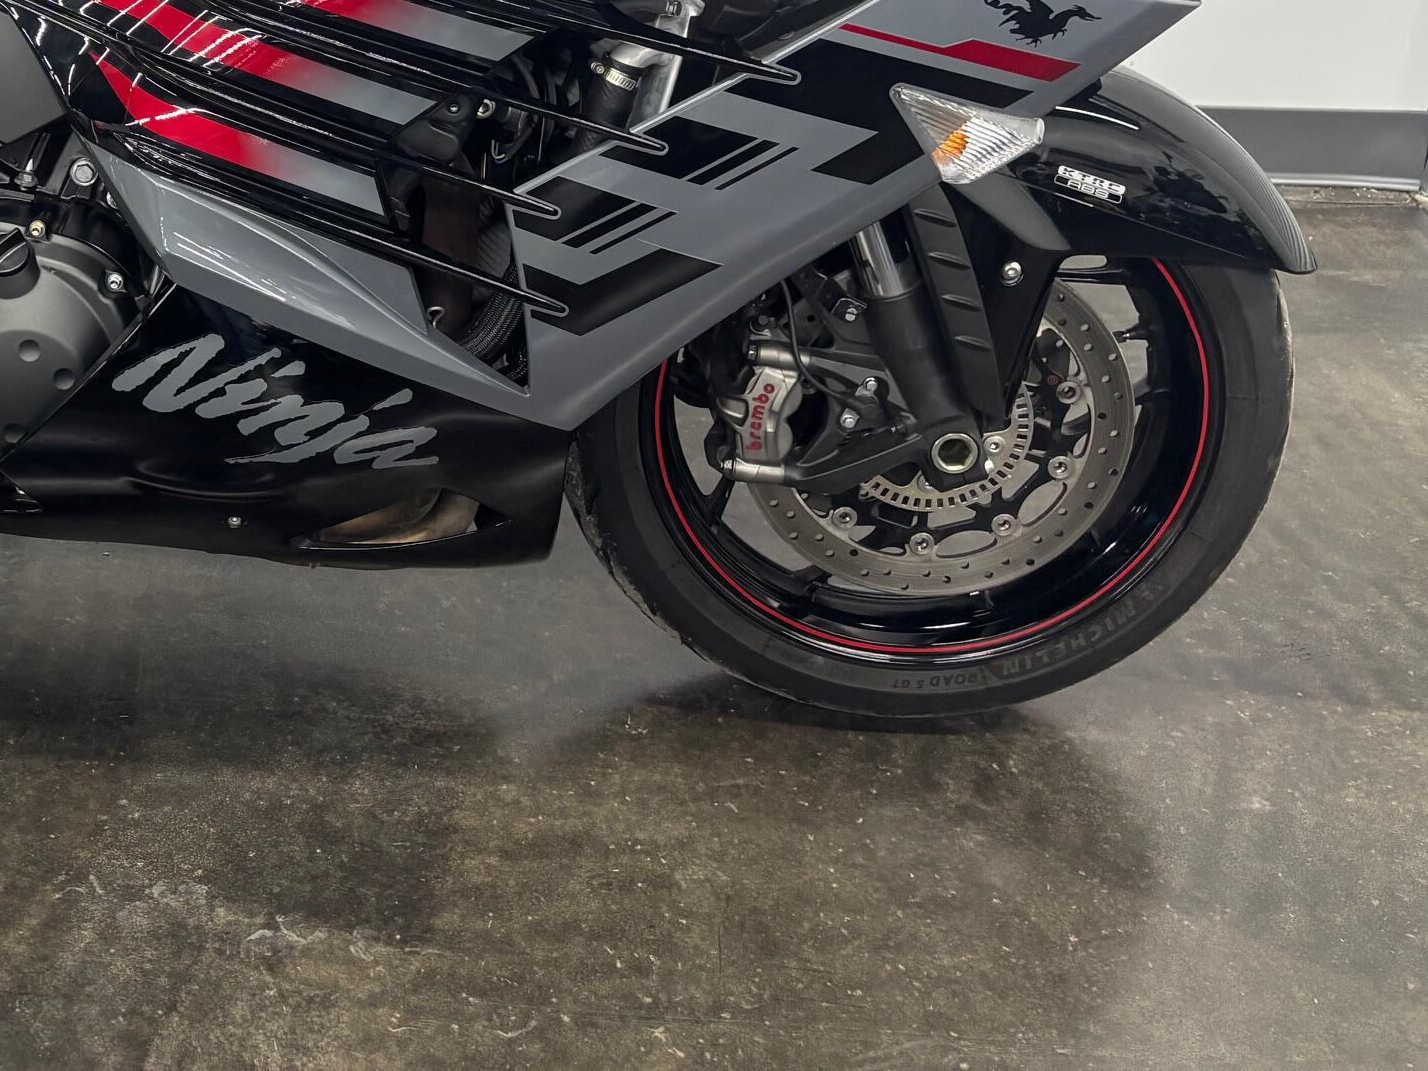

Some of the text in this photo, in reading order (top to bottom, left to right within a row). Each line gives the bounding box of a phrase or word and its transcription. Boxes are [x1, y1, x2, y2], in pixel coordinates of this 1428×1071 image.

[1061, 167, 1122, 193] KTRC
[1067, 179, 1109, 200] ABS
[111, 333, 441, 470] Ninja
[747, 383, 775, 453] brembo
[1002, 600, 1139, 677] MICHELIN
